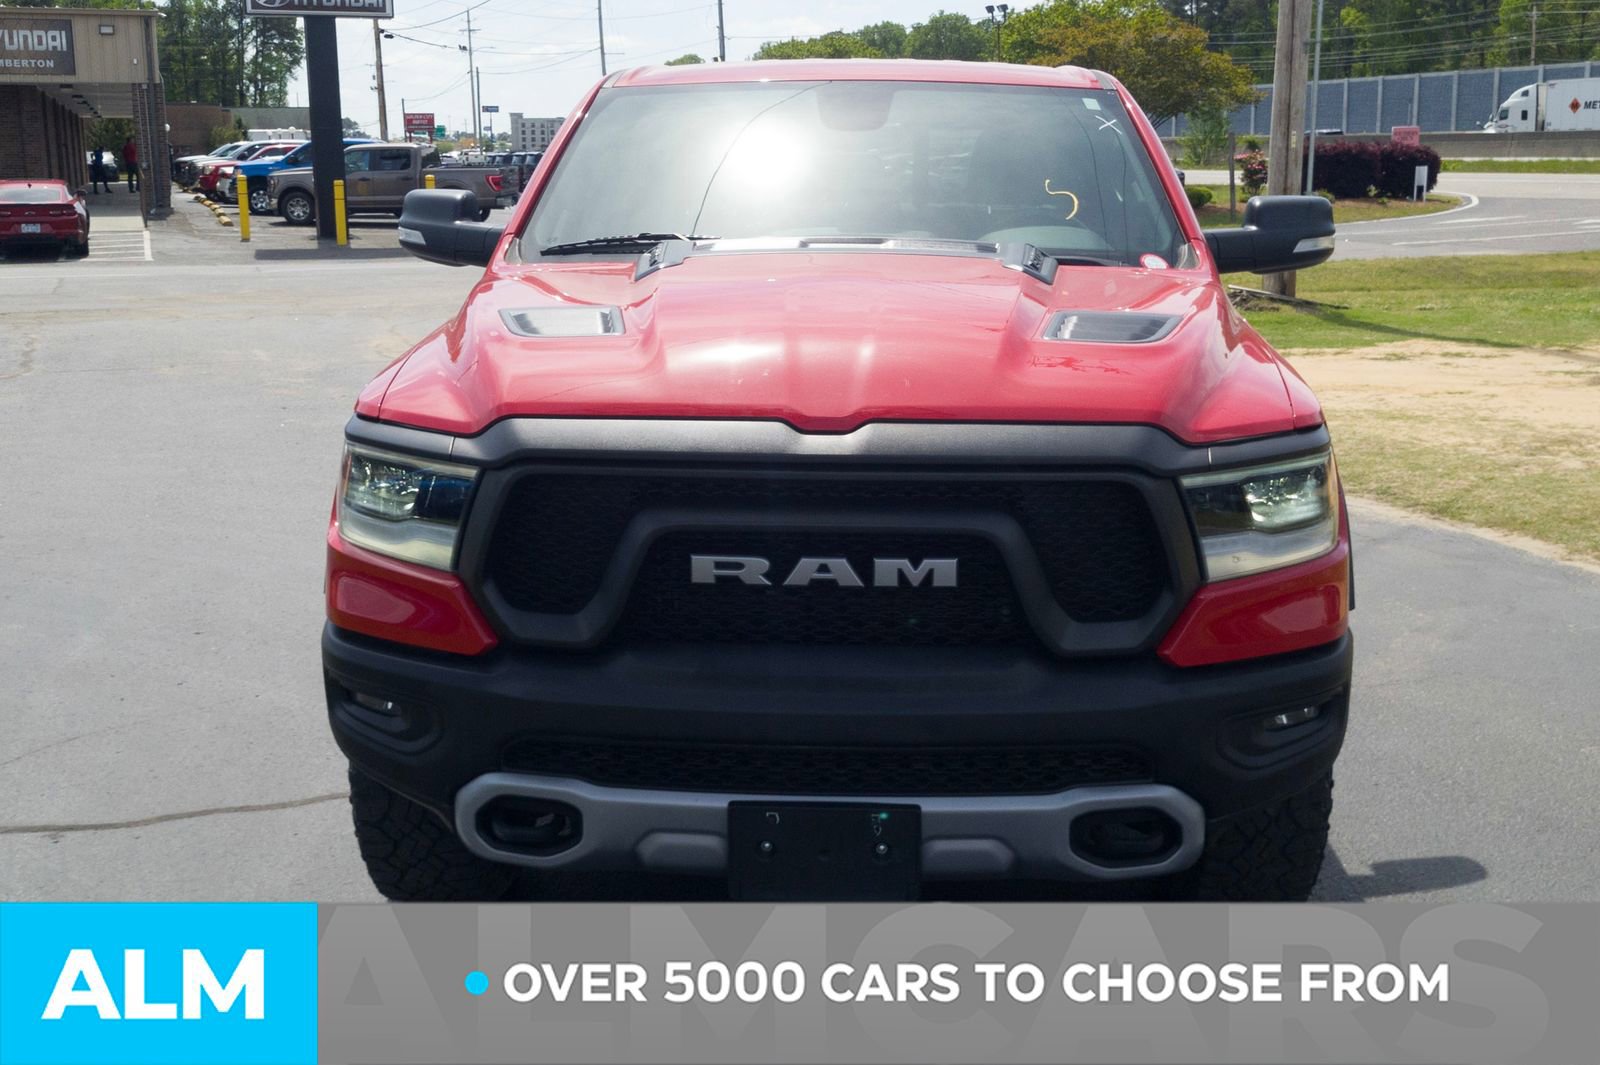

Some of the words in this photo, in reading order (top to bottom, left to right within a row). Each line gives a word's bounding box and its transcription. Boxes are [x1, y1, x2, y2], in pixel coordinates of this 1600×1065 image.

[0, 30, 67, 51] UNDAI
[1583, 101, 1600, 109] ME
[691, 555, 958, 587] RAM
